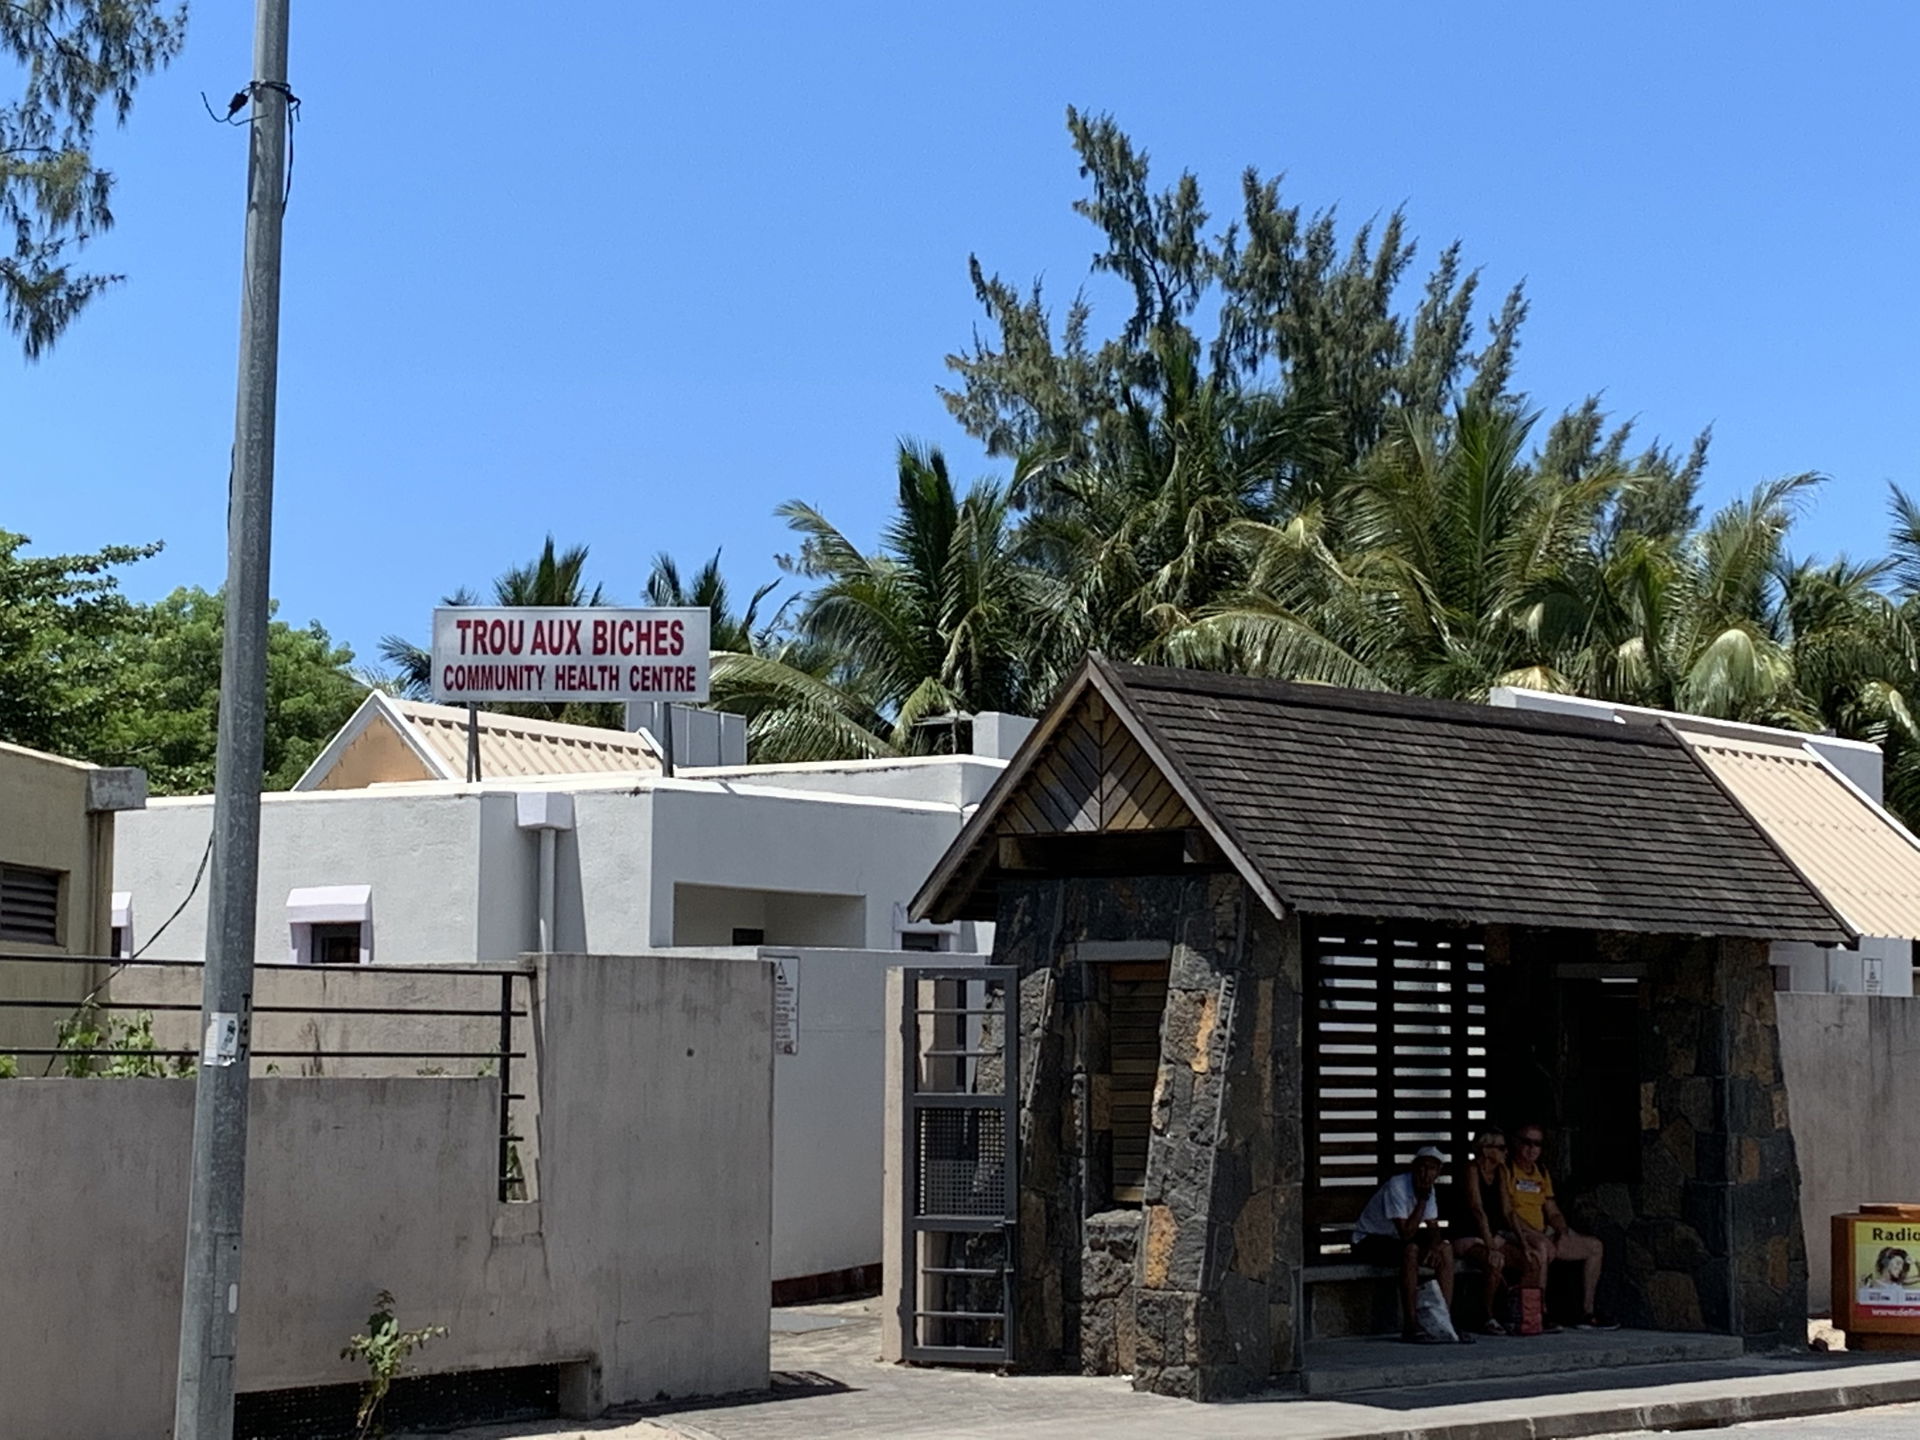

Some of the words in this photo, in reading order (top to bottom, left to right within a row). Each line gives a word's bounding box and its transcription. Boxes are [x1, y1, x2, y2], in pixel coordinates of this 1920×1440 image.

[456, 619, 524, 656] TROU
[530, 619, 582, 656] AUX
[592, 619, 685, 656] BICHES
[443, 664, 545, 692] COMMUNITY
[554, 665, 620, 692] HEALTH
[629, 665, 696, 693] CENTRE
